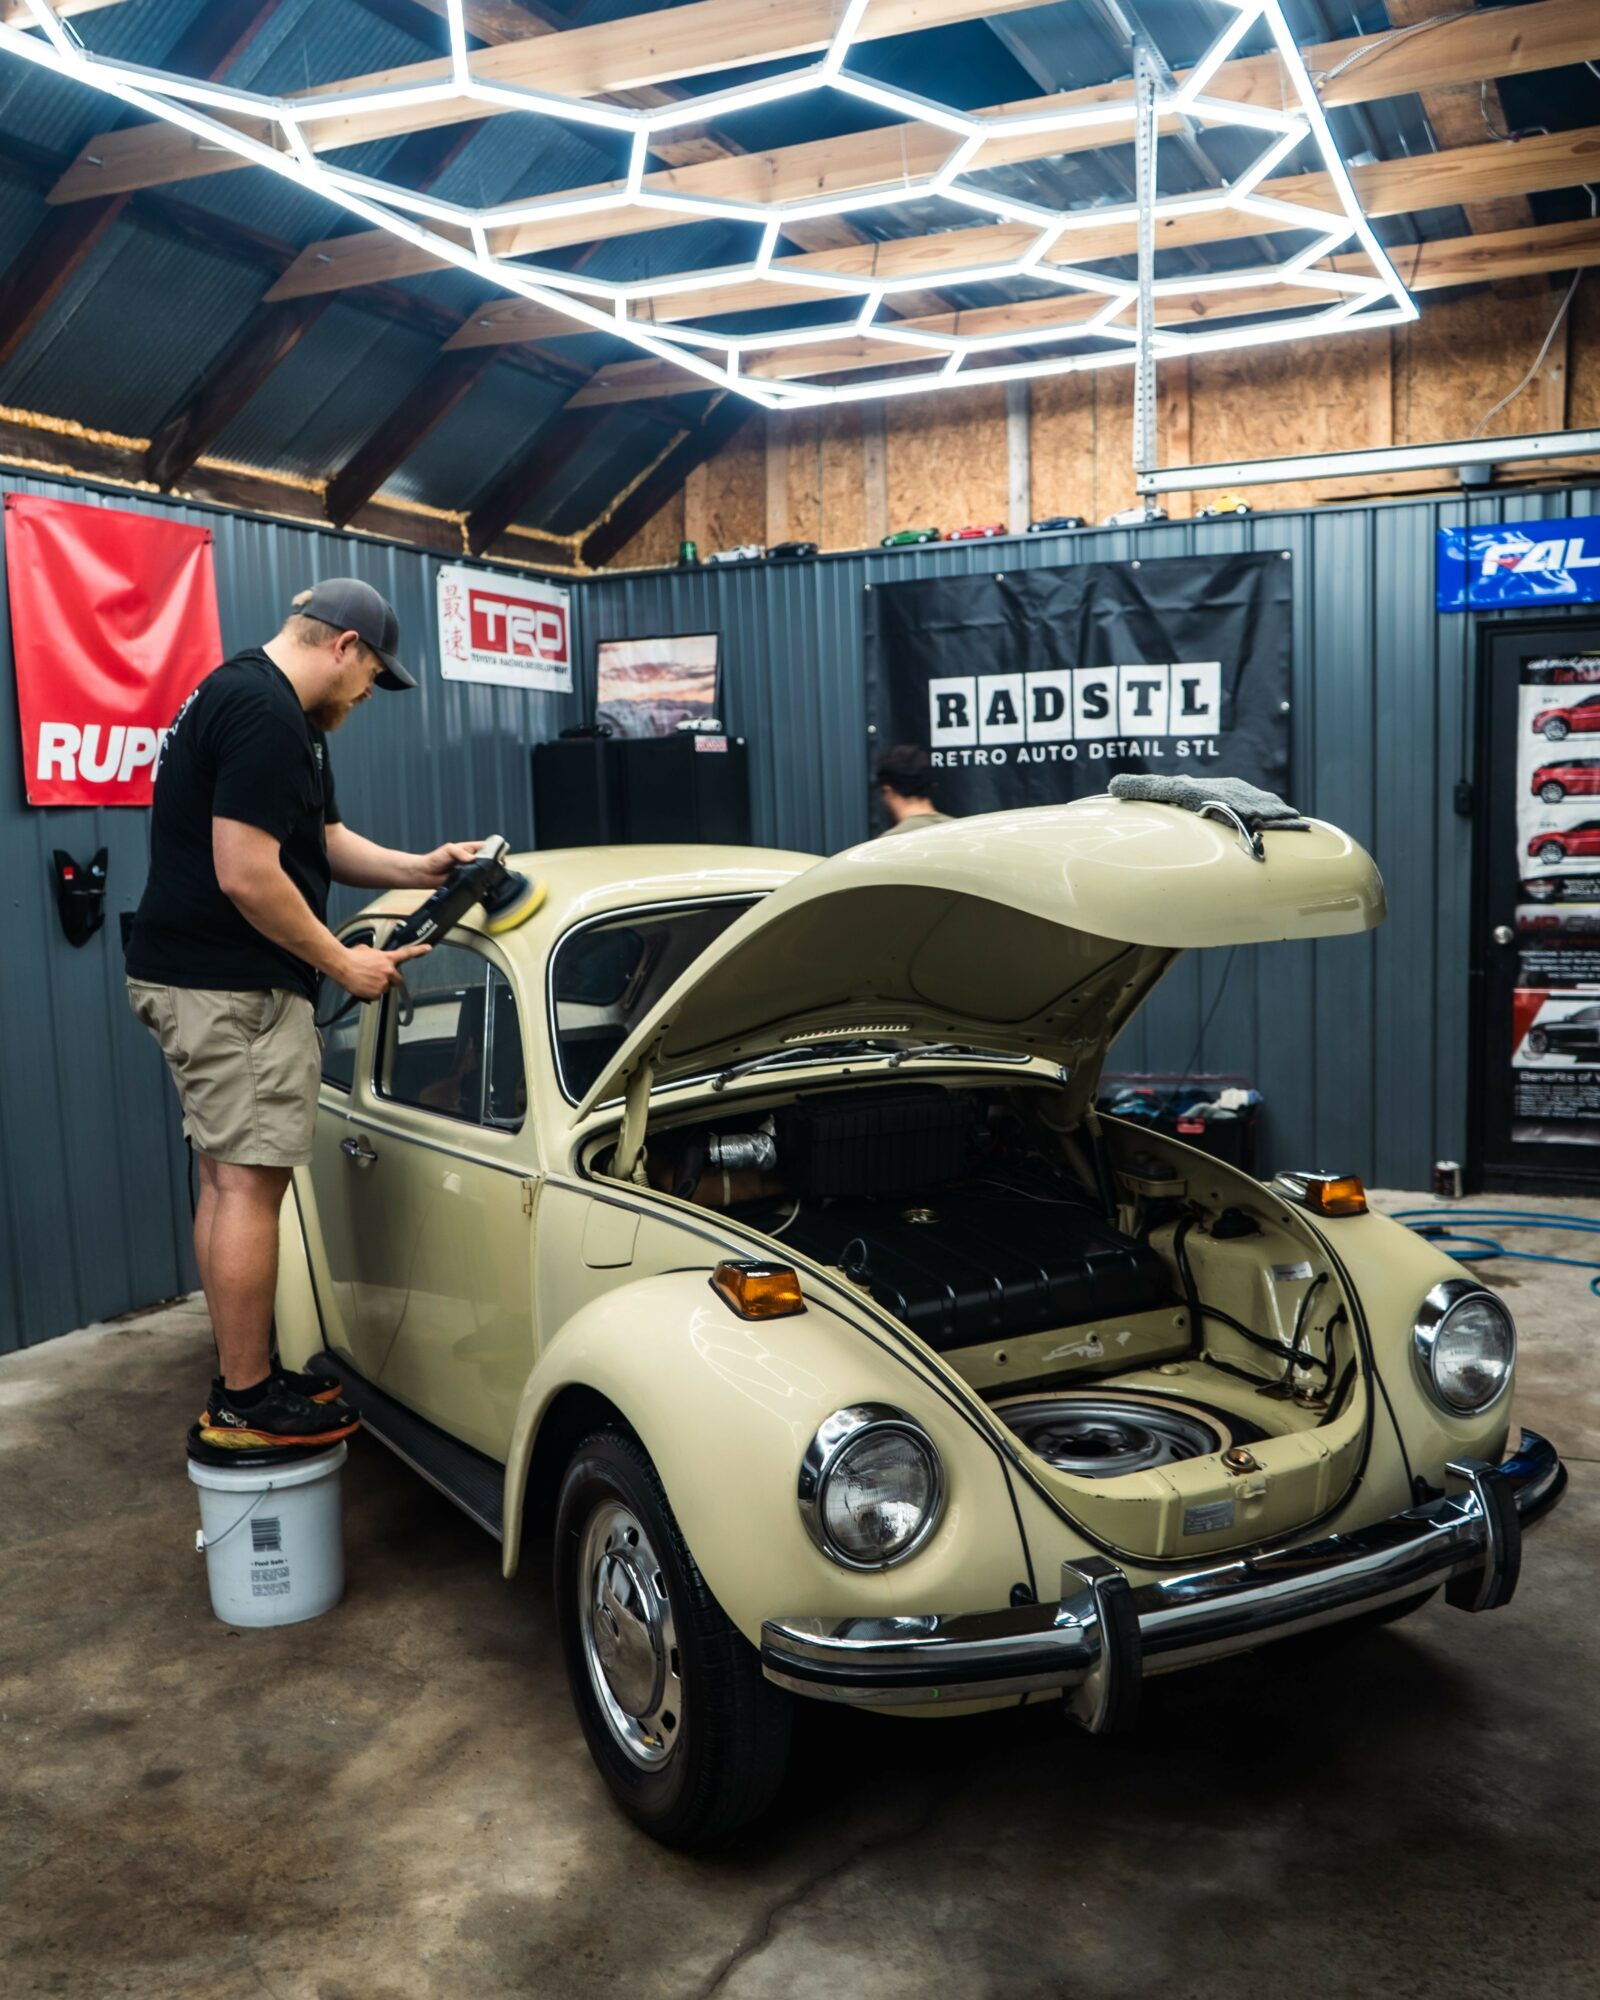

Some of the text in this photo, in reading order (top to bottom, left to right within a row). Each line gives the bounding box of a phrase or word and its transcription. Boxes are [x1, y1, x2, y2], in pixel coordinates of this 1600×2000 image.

[1482, 538, 1600, 576] FAL
[473, 598, 562, 658] TRD
[936, 678, 1209, 728] RADSTL
[931, 740, 1220, 767] RETRO AUTO DETAIL STL
[1520, 1071, 1575, 1083] Benefits
[217, 1408, 248, 1429] HOKA
